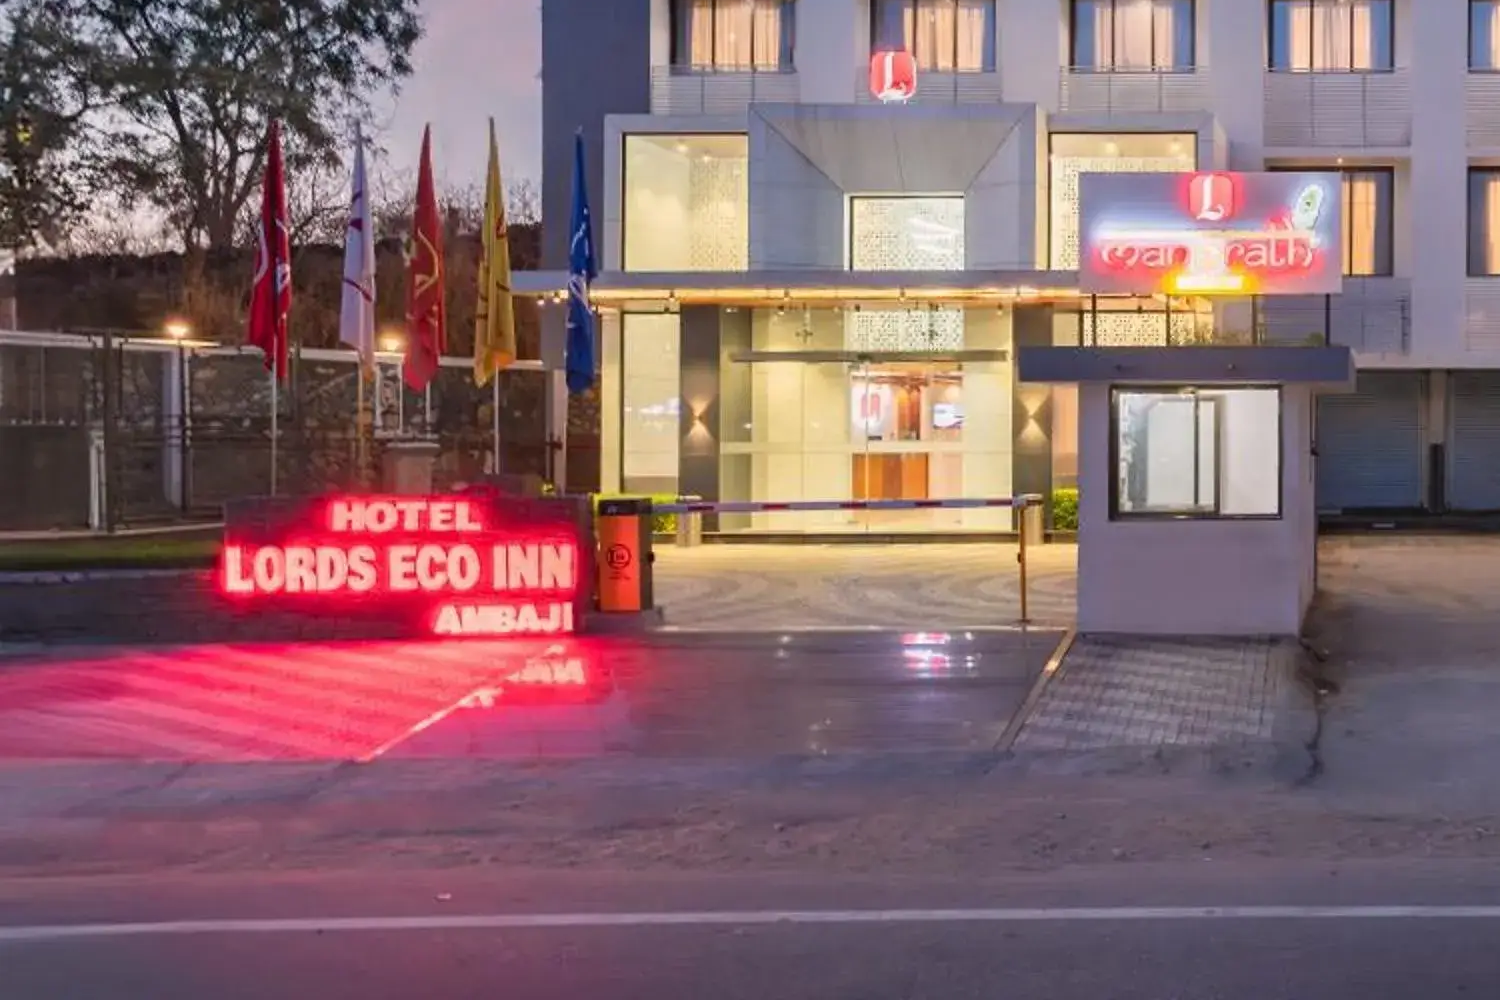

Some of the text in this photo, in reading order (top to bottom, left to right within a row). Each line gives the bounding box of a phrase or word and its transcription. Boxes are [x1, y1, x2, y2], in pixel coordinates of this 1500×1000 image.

[1195, 174, 1226, 221] L
[331, 500, 483, 532] HOTEL
[224, 545, 378, 593] LORDS
[388, 543, 482, 591] ECO
[492, 543, 575, 590] INN
[433, 602, 574, 634] AMBAJI
